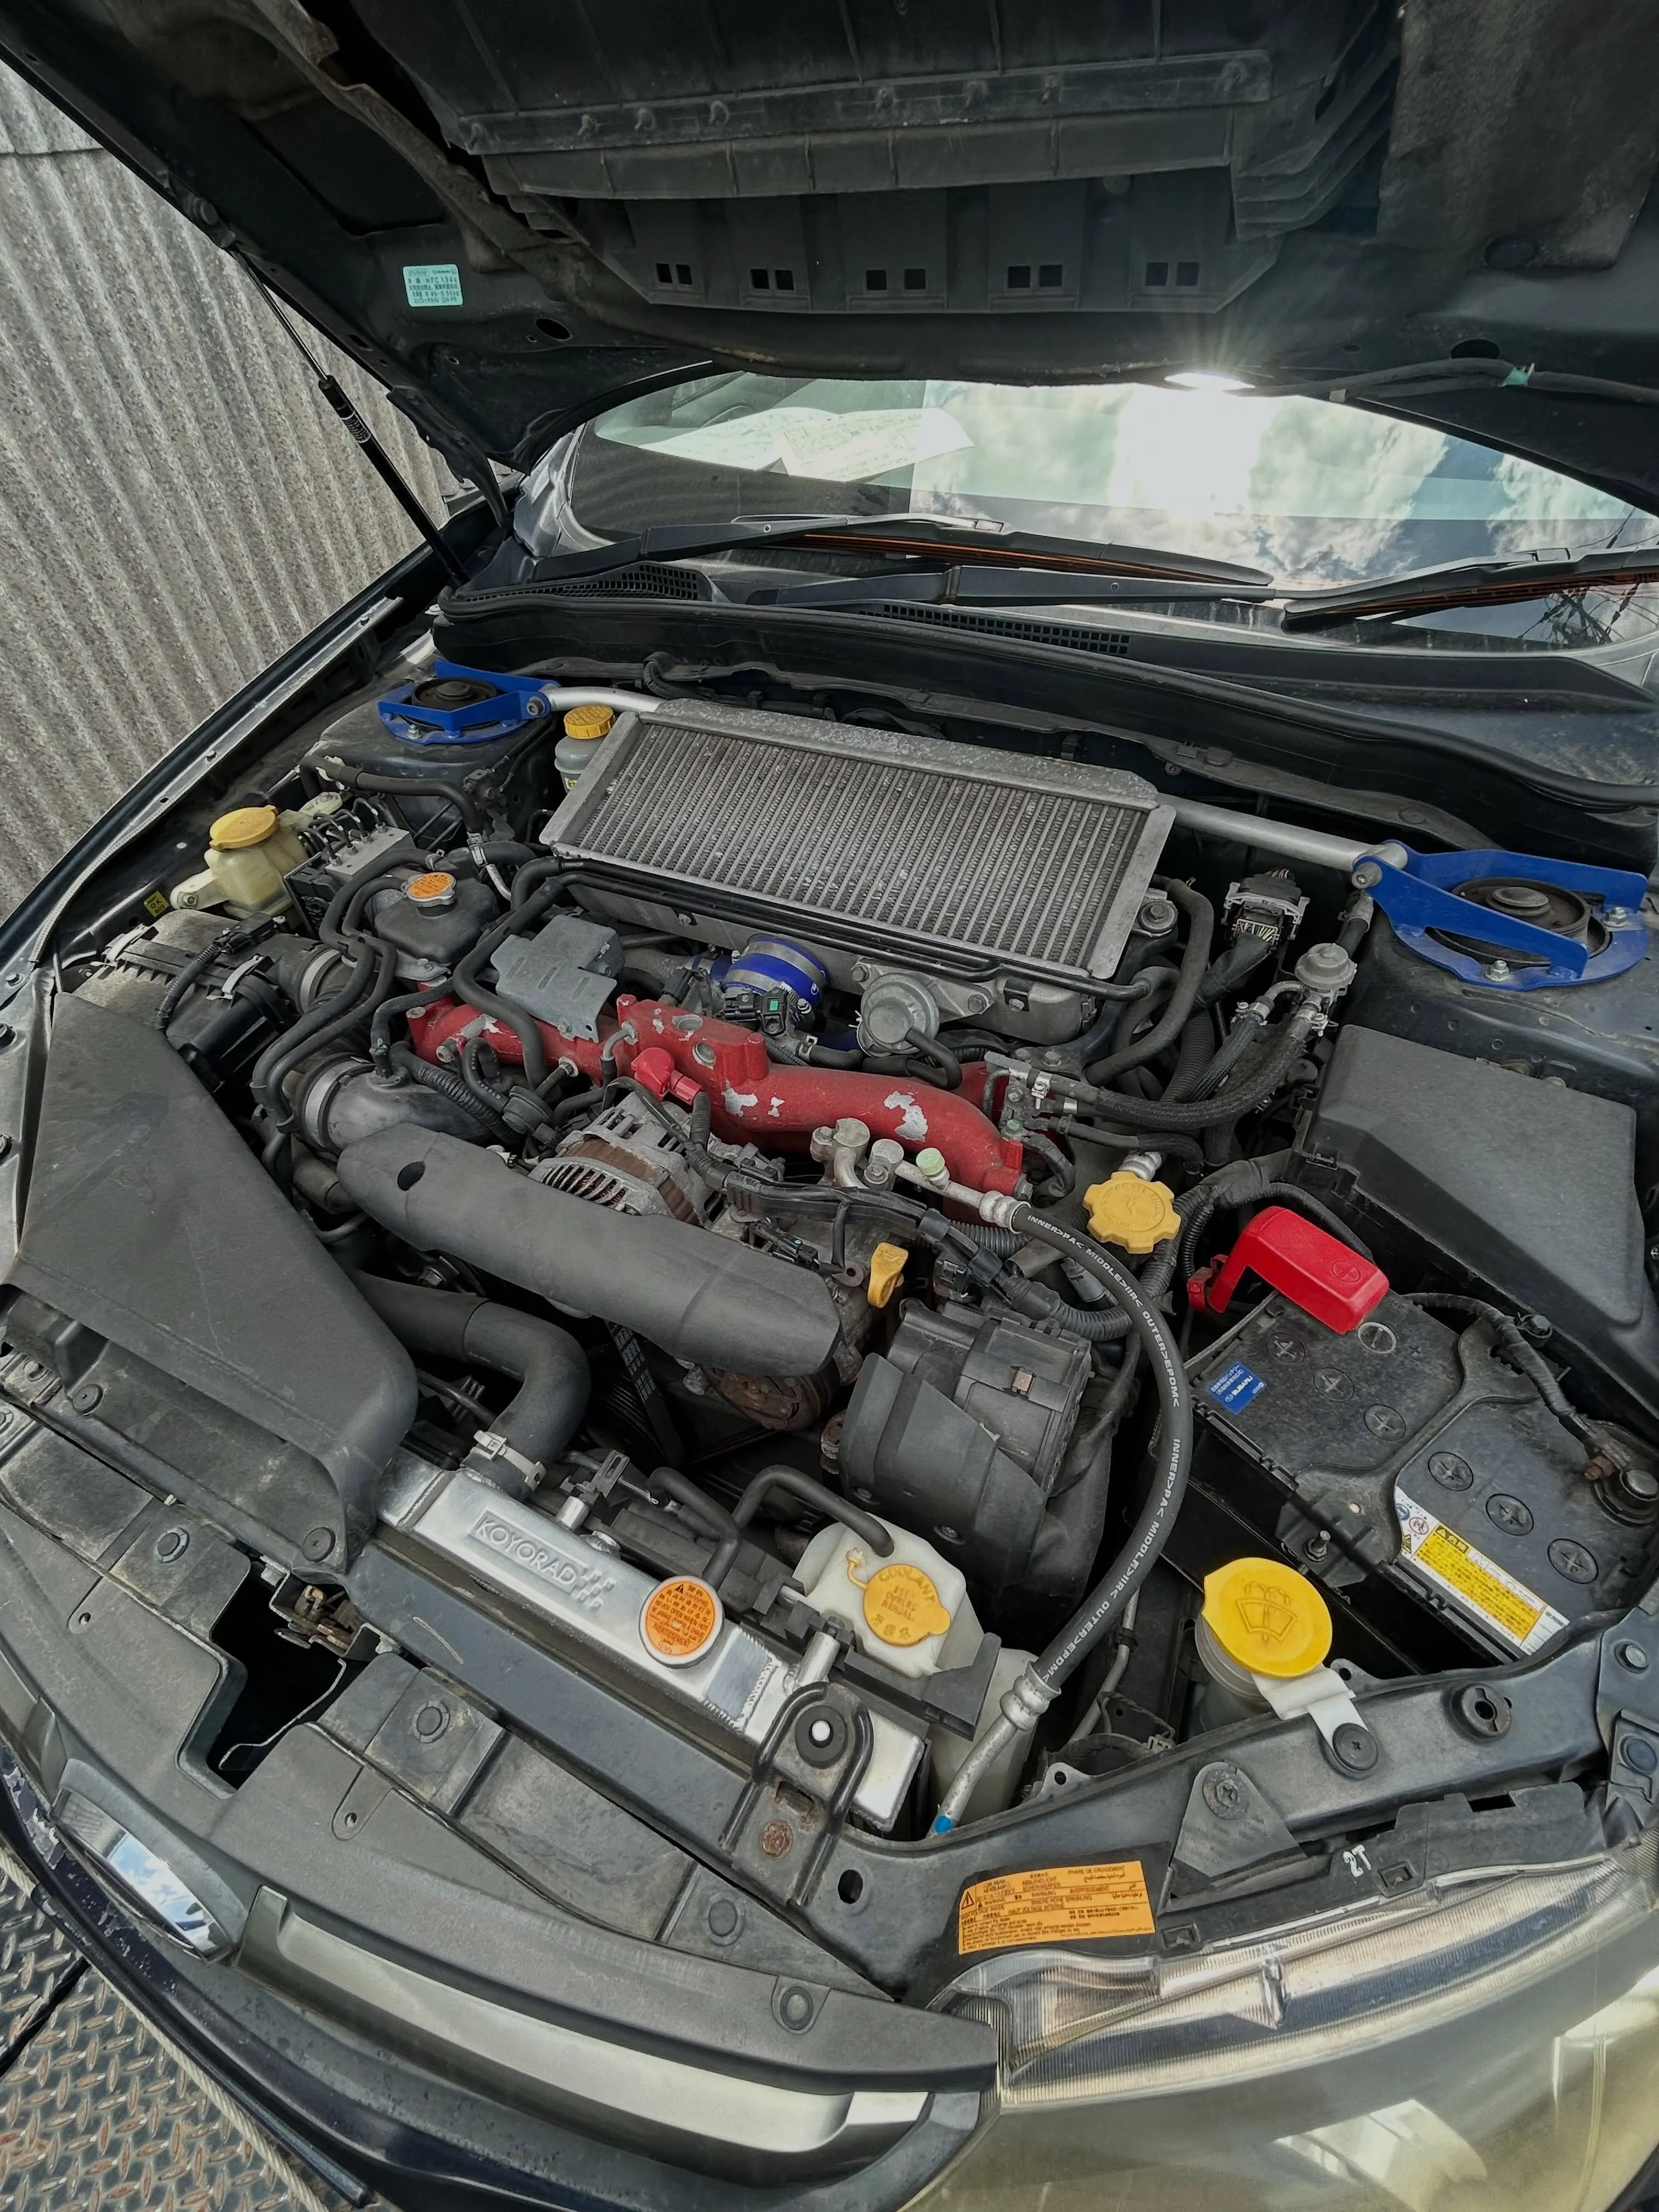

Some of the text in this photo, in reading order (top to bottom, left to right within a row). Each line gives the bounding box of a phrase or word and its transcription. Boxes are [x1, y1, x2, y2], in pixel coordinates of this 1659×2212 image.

[1028, 1215, 1084, 1249] INNER>PA<
[1086, 1248, 1143, 1307] MIDDLE>IIR<
[1143, 1311, 1180, 1407] OUTER>EPDM<
[1157, 1438, 1180, 1517] INNER>PA<
[475, 1518, 577, 1585] KOYORAD
[879, 1566, 936, 1602] COOLANT
[1042, 1601, 1110, 1683] OUTER>EPDM<
